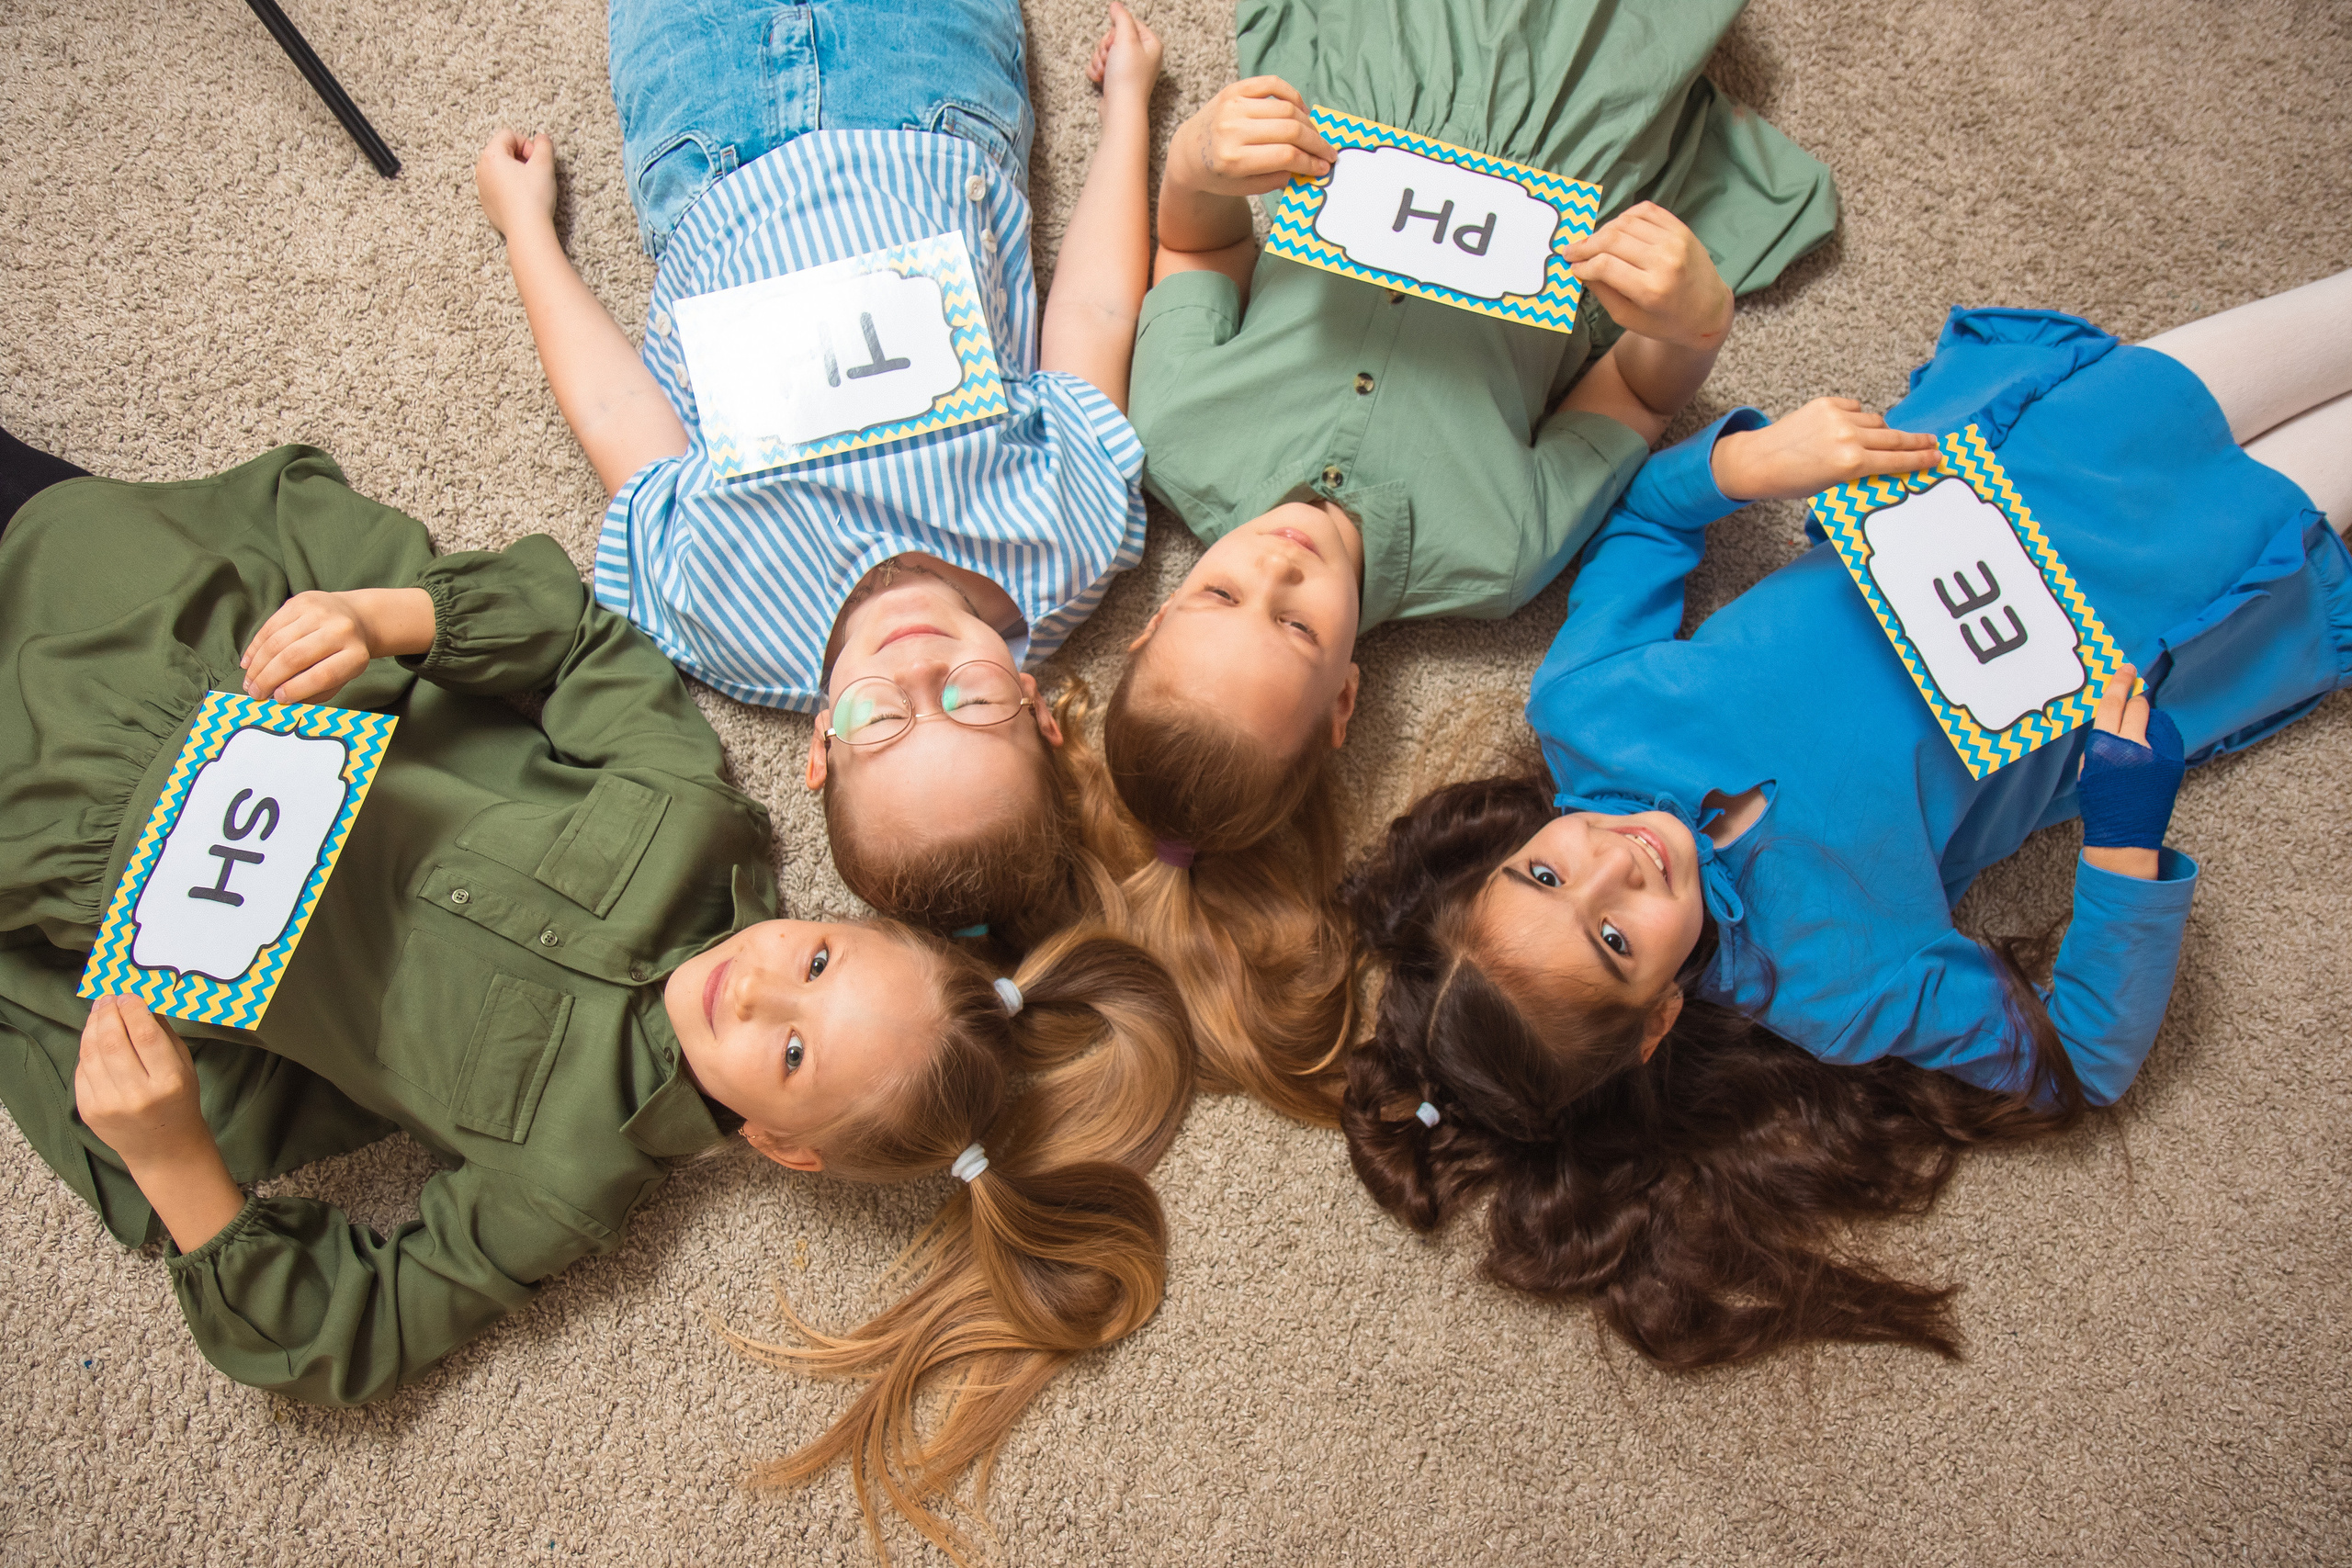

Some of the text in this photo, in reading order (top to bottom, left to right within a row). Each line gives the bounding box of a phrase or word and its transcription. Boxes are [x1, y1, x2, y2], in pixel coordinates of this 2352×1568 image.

[1392, 186, 1498, 256] PH
[1932, 559, 2029, 665] EE
[187, 786, 281, 908] SH
